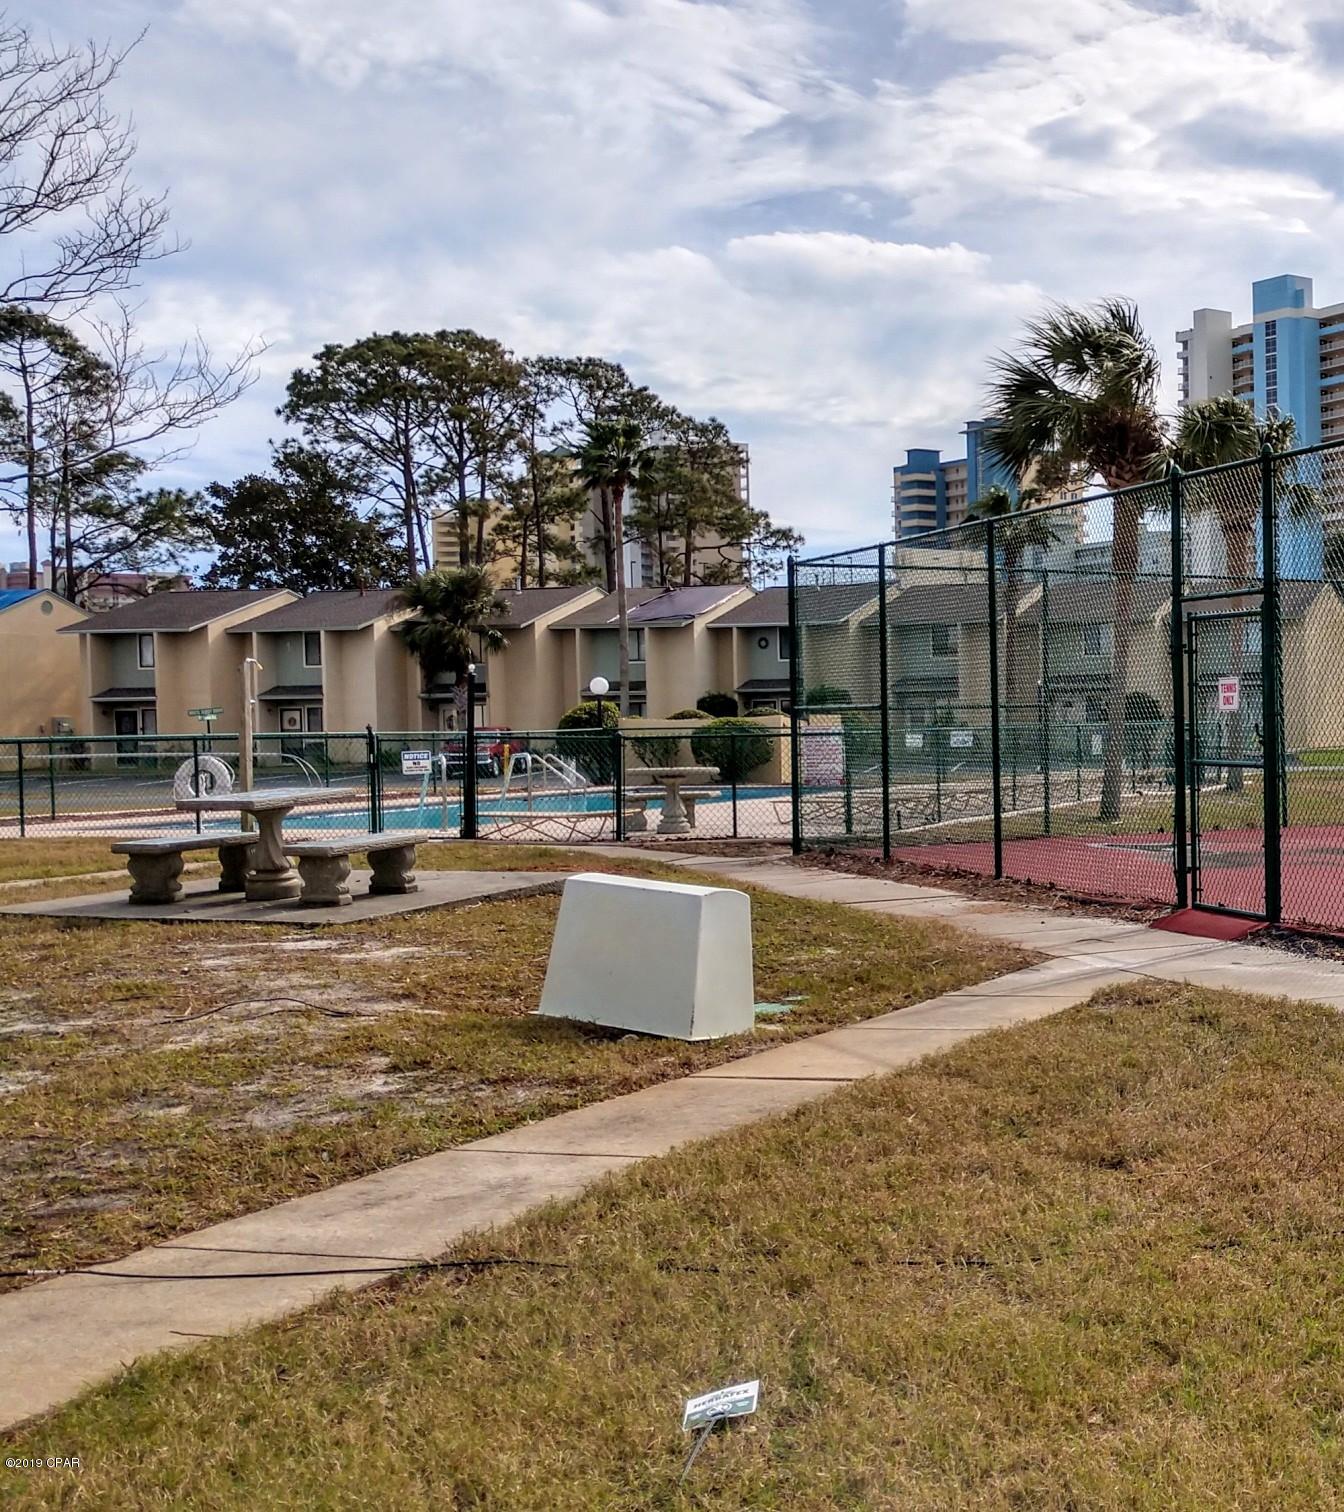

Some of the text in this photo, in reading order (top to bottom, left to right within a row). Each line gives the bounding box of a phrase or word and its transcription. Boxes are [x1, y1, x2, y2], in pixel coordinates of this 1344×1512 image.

[1221, 683, 1237, 694] TENNIS
[1222, 695, 1234, 706] ONLY
[403, 753, 429, 761] NOTICE
